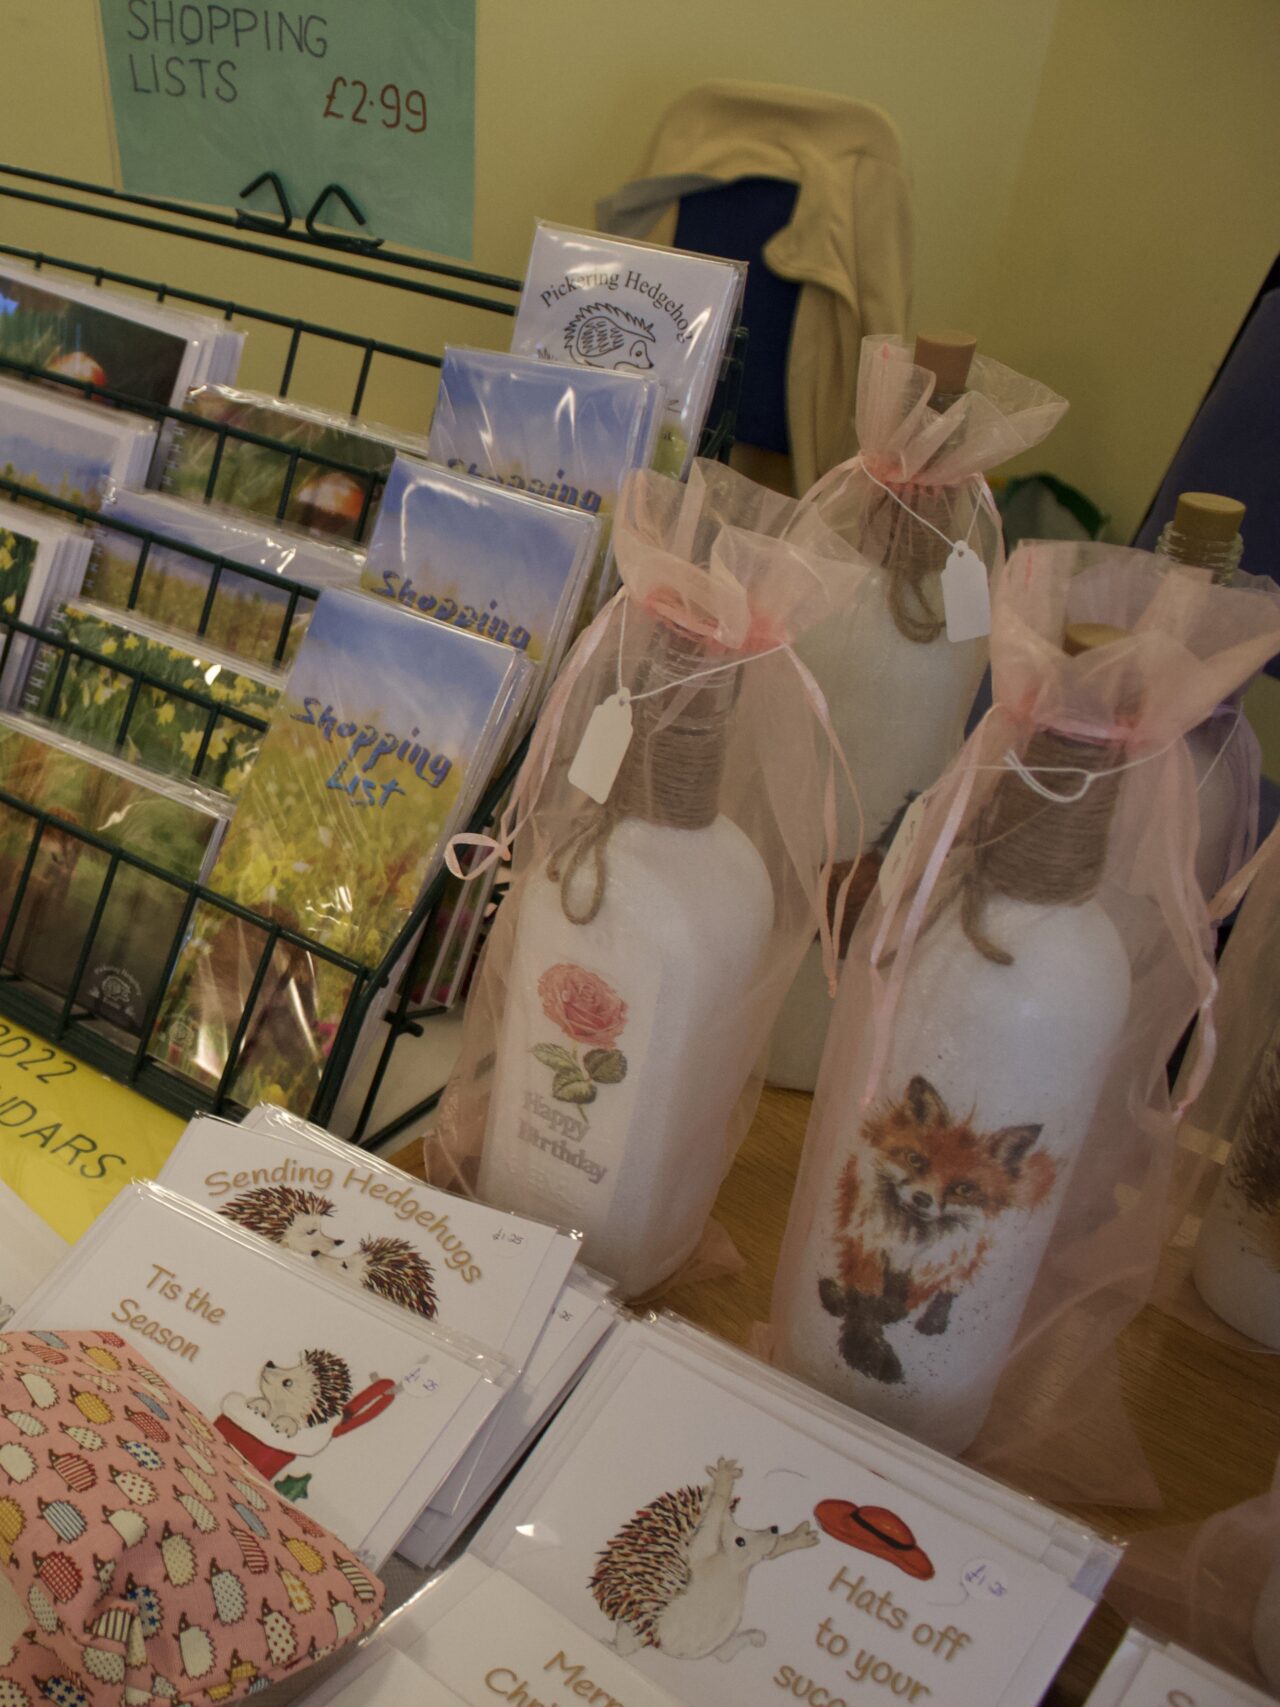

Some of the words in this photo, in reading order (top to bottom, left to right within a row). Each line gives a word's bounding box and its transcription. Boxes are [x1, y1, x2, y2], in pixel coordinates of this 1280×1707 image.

[127, 0, 328, 58] SHOPPING
[128, 53, 238, 103] LISTS
[540, 271, 621, 308] Pickering
[623, 270, 694, 345] Hedgehog
[289, 696, 453, 789] Shopping
[203, 1158, 333, 1198] Sending
[342, 1166, 483, 1286] Hedgehugs
[111, 1298, 200, 1363] Season
[146, 1263, 183, 1301] Tis
[184, 1287, 226, 1325] the
[828, 1565, 909, 1631] Hats
[911, 1623, 973, 1663] off
[815, 1616, 850, 1657] to
[845, 1648, 931, 1704] your
